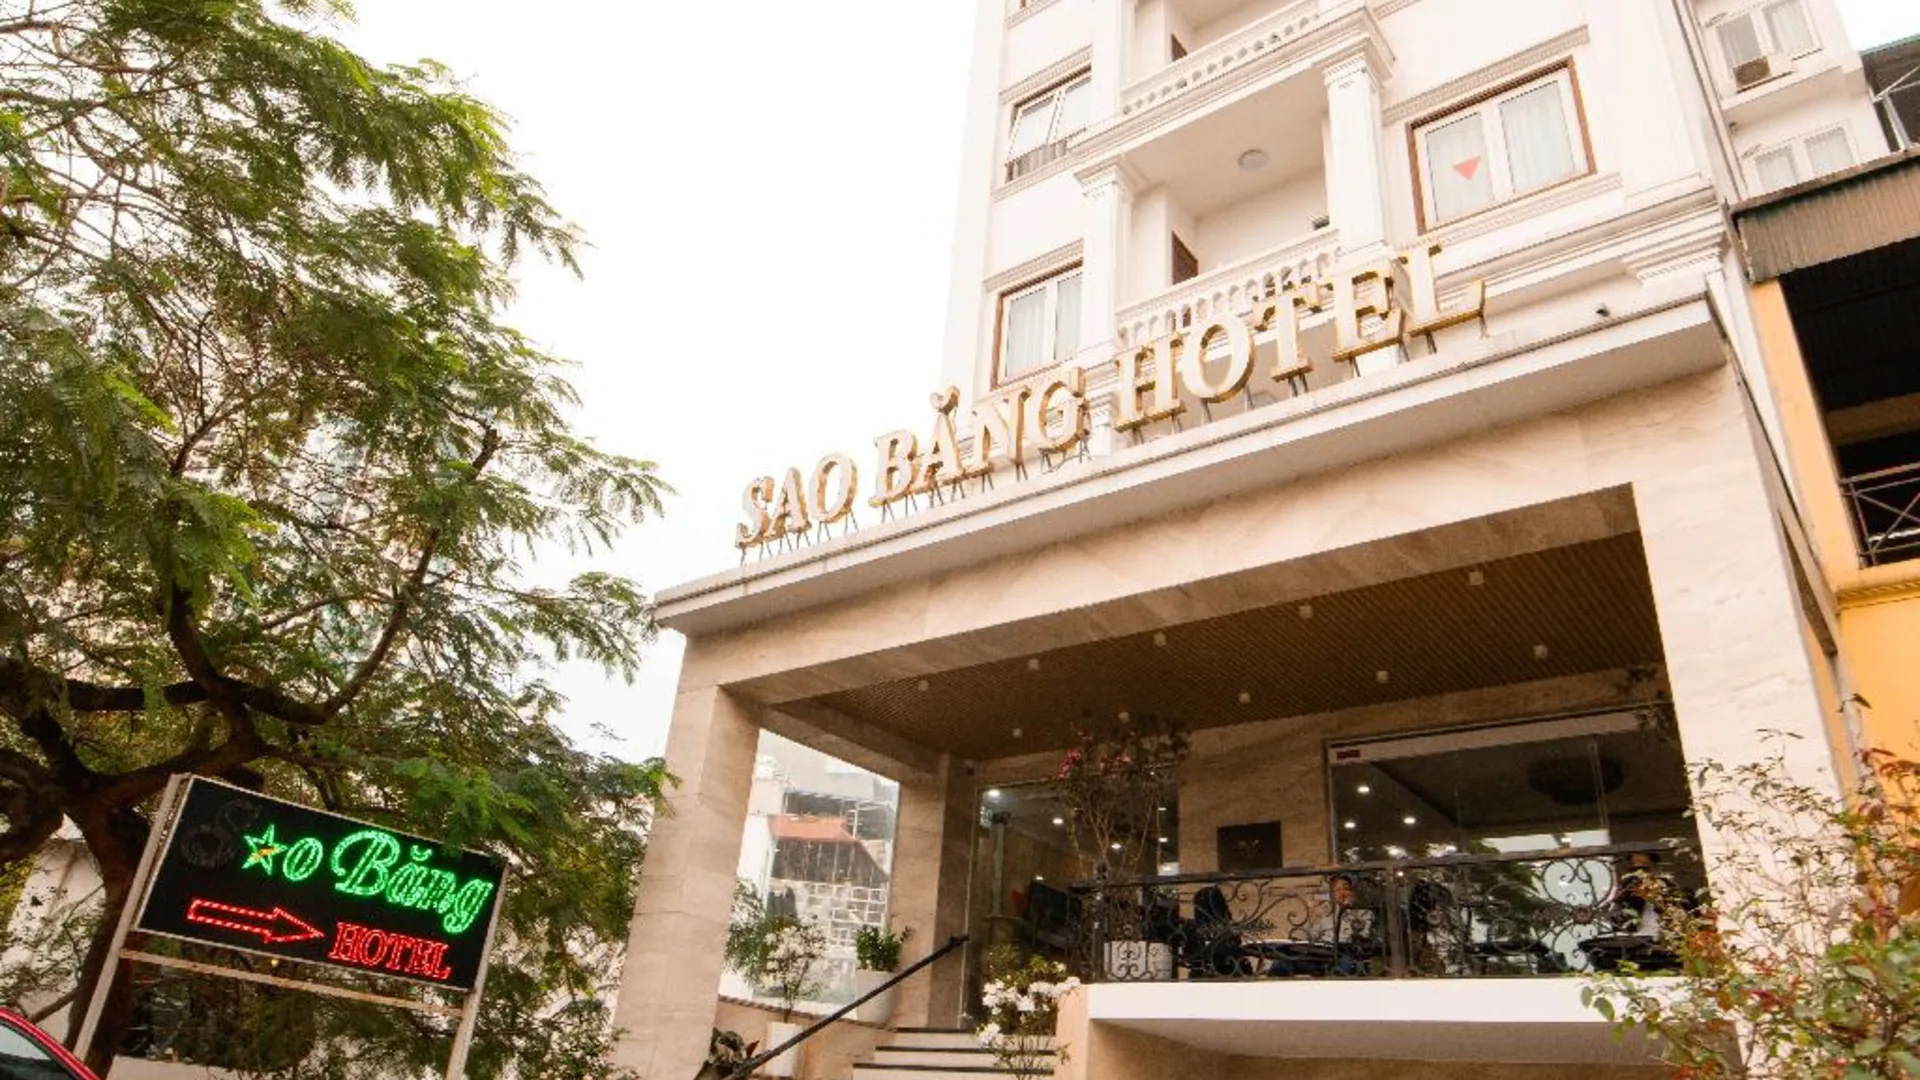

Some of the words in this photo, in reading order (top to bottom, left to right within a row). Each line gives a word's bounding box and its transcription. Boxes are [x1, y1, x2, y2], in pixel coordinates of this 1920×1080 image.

[736, 452, 859, 548] SAO
[869, 366, 1088, 508] BĂNG
[1113, 235, 1486, 433] HOTEL
[331, 829, 494, 934] Băng
[327, 921, 453, 980] HOTEL
